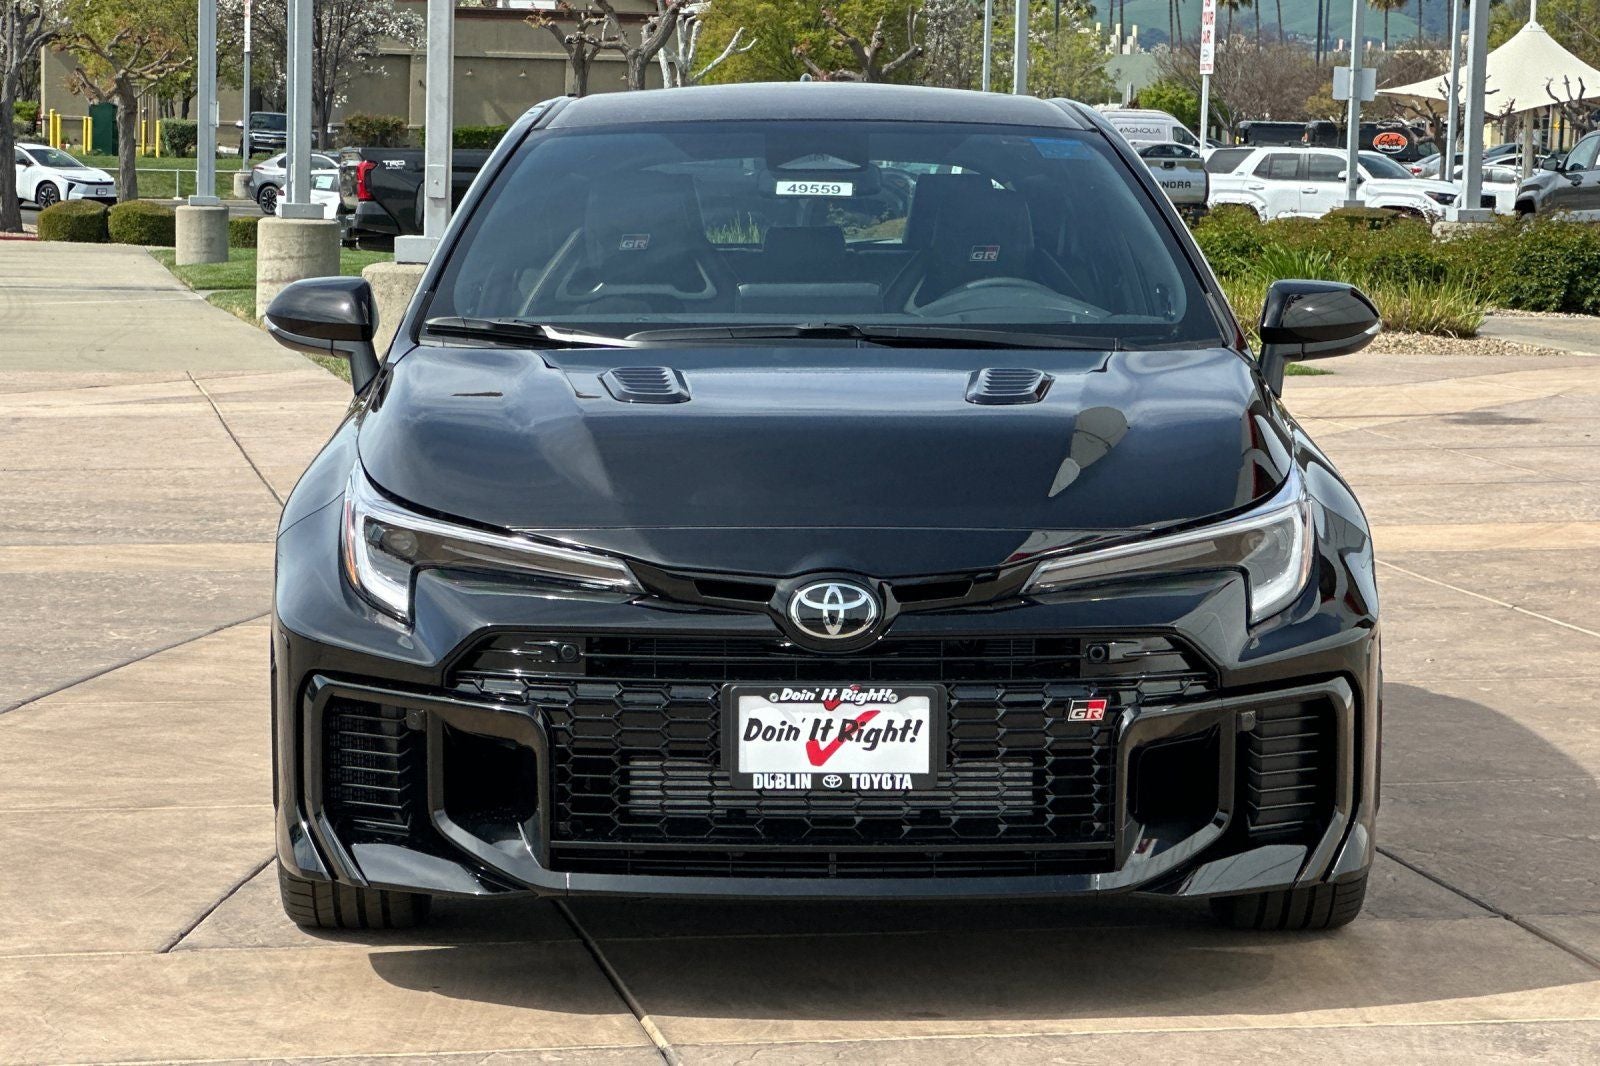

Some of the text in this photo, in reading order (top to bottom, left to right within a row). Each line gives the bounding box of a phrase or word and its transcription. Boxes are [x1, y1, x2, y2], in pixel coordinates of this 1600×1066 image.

[787, 183, 842, 195] 49559
[1161, 180, 1192, 189] NDRA
[621, 239, 647, 248] GR
[972, 251, 997, 260] GR
[780, 688, 892, 705] Doin' It Right!
[1070, 708, 1103, 719] GR
[743, 718, 923, 751] Doin' It Right!
[754, 774, 913, 790] DUBLIN TOYOTA
